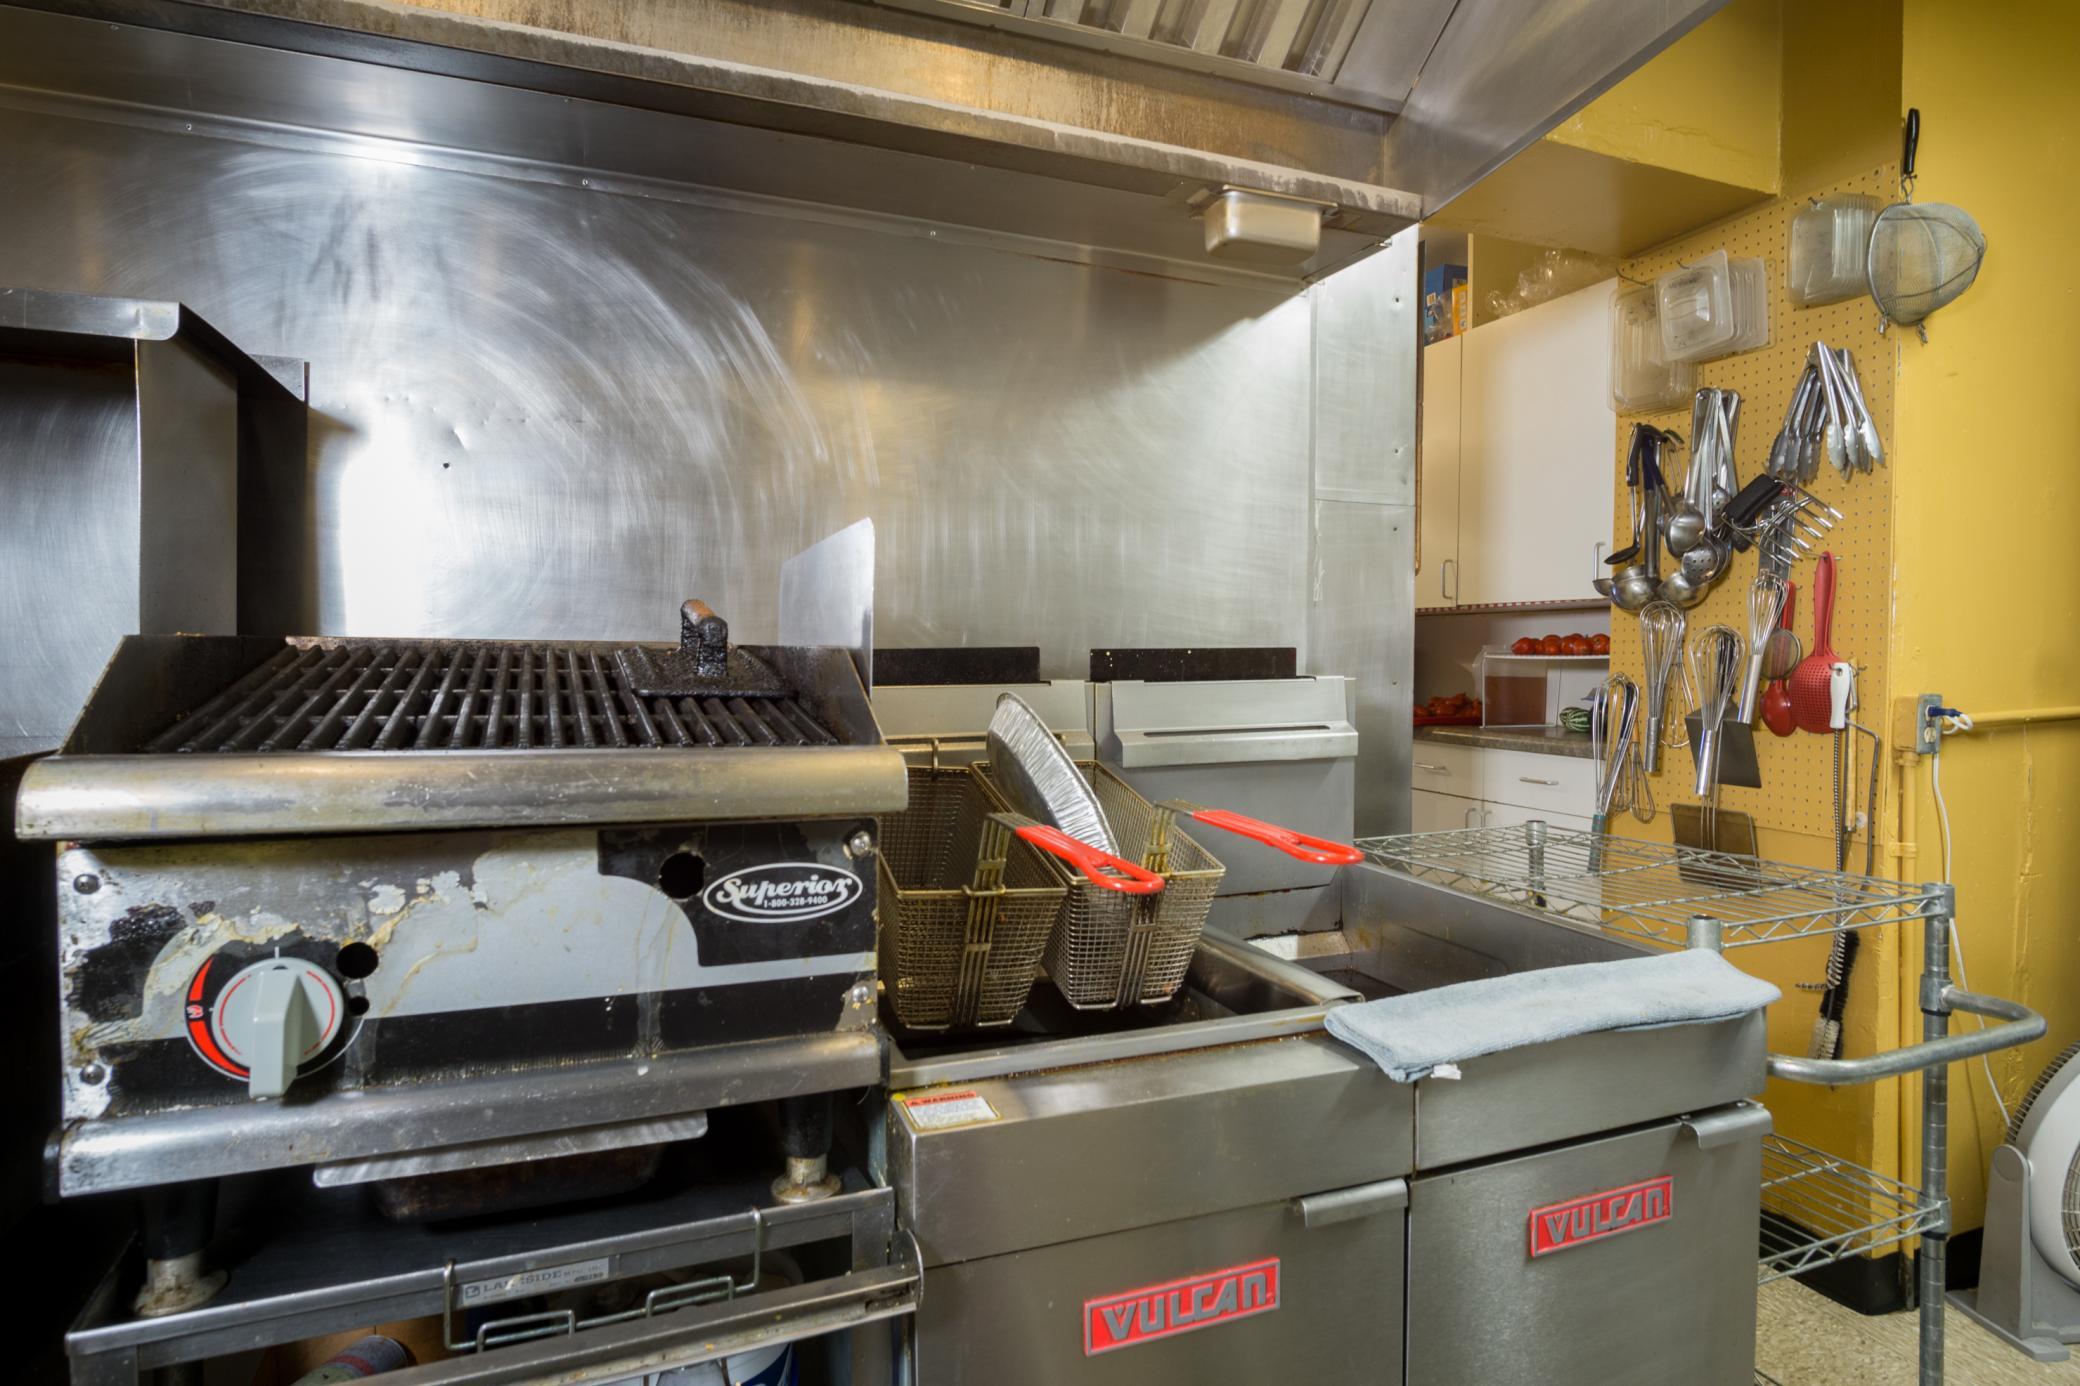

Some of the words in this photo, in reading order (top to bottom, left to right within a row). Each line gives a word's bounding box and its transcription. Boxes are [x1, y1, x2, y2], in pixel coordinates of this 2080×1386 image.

[716, 874, 853, 906] Superior
[1545, 1187, 1664, 1244] VULCAN
[1102, 1272, 1267, 1341] VULCAN
